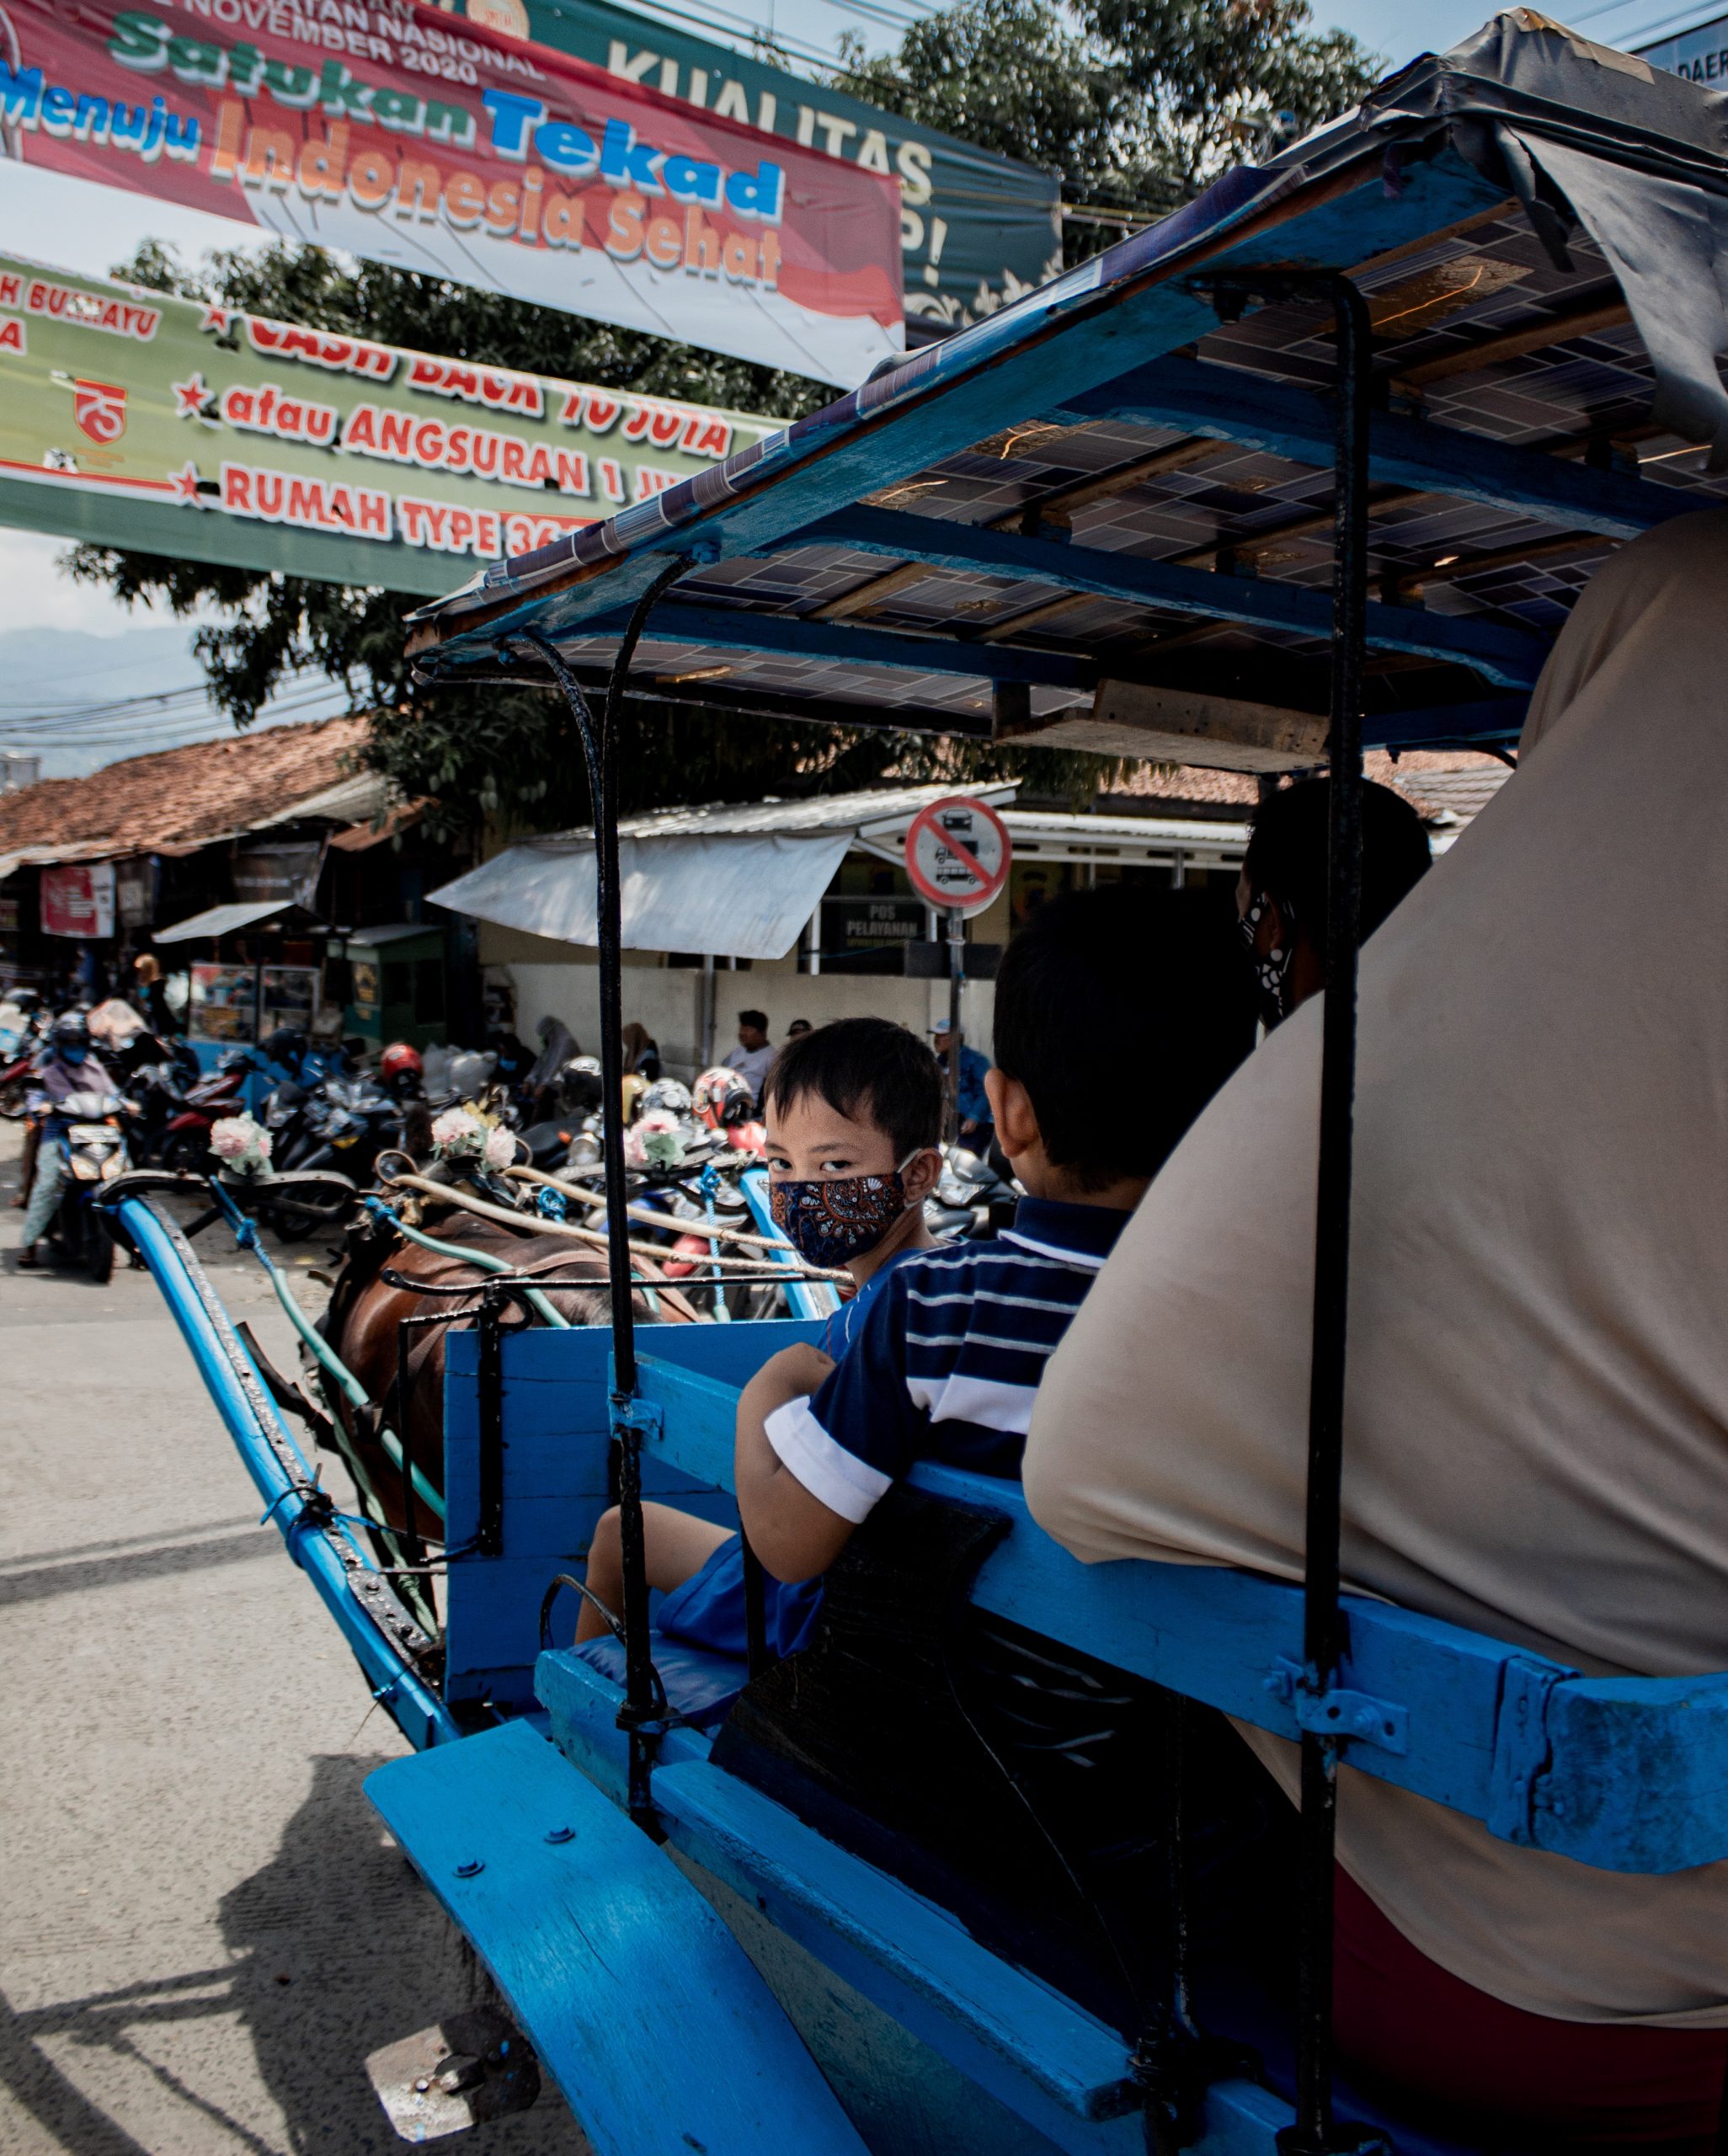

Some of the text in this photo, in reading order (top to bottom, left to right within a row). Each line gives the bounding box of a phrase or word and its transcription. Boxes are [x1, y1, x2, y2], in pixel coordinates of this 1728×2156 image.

[184, 0, 394, 66] NOVEMBER
[399, 45, 477, 85] 2020
[378, 13, 547, 82] NASIONAL
[106, 9, 785, 226] Satukan Tekad
[0, 58, 783, 291] Menuju Indonesia Sehat
[225, 387, 333, 440] atau
[346, 404, 587, 492] ANGSURAN
[600, 462, 619, 497] 1
[626, 400, 729, 456] JUTA
[223, 467, 389, 536] RUMAH
[400, 499, 498, 554] TYPE
[846, 921, 918, 937] PELAYANAN
[869, 904, 897, 921] POS
